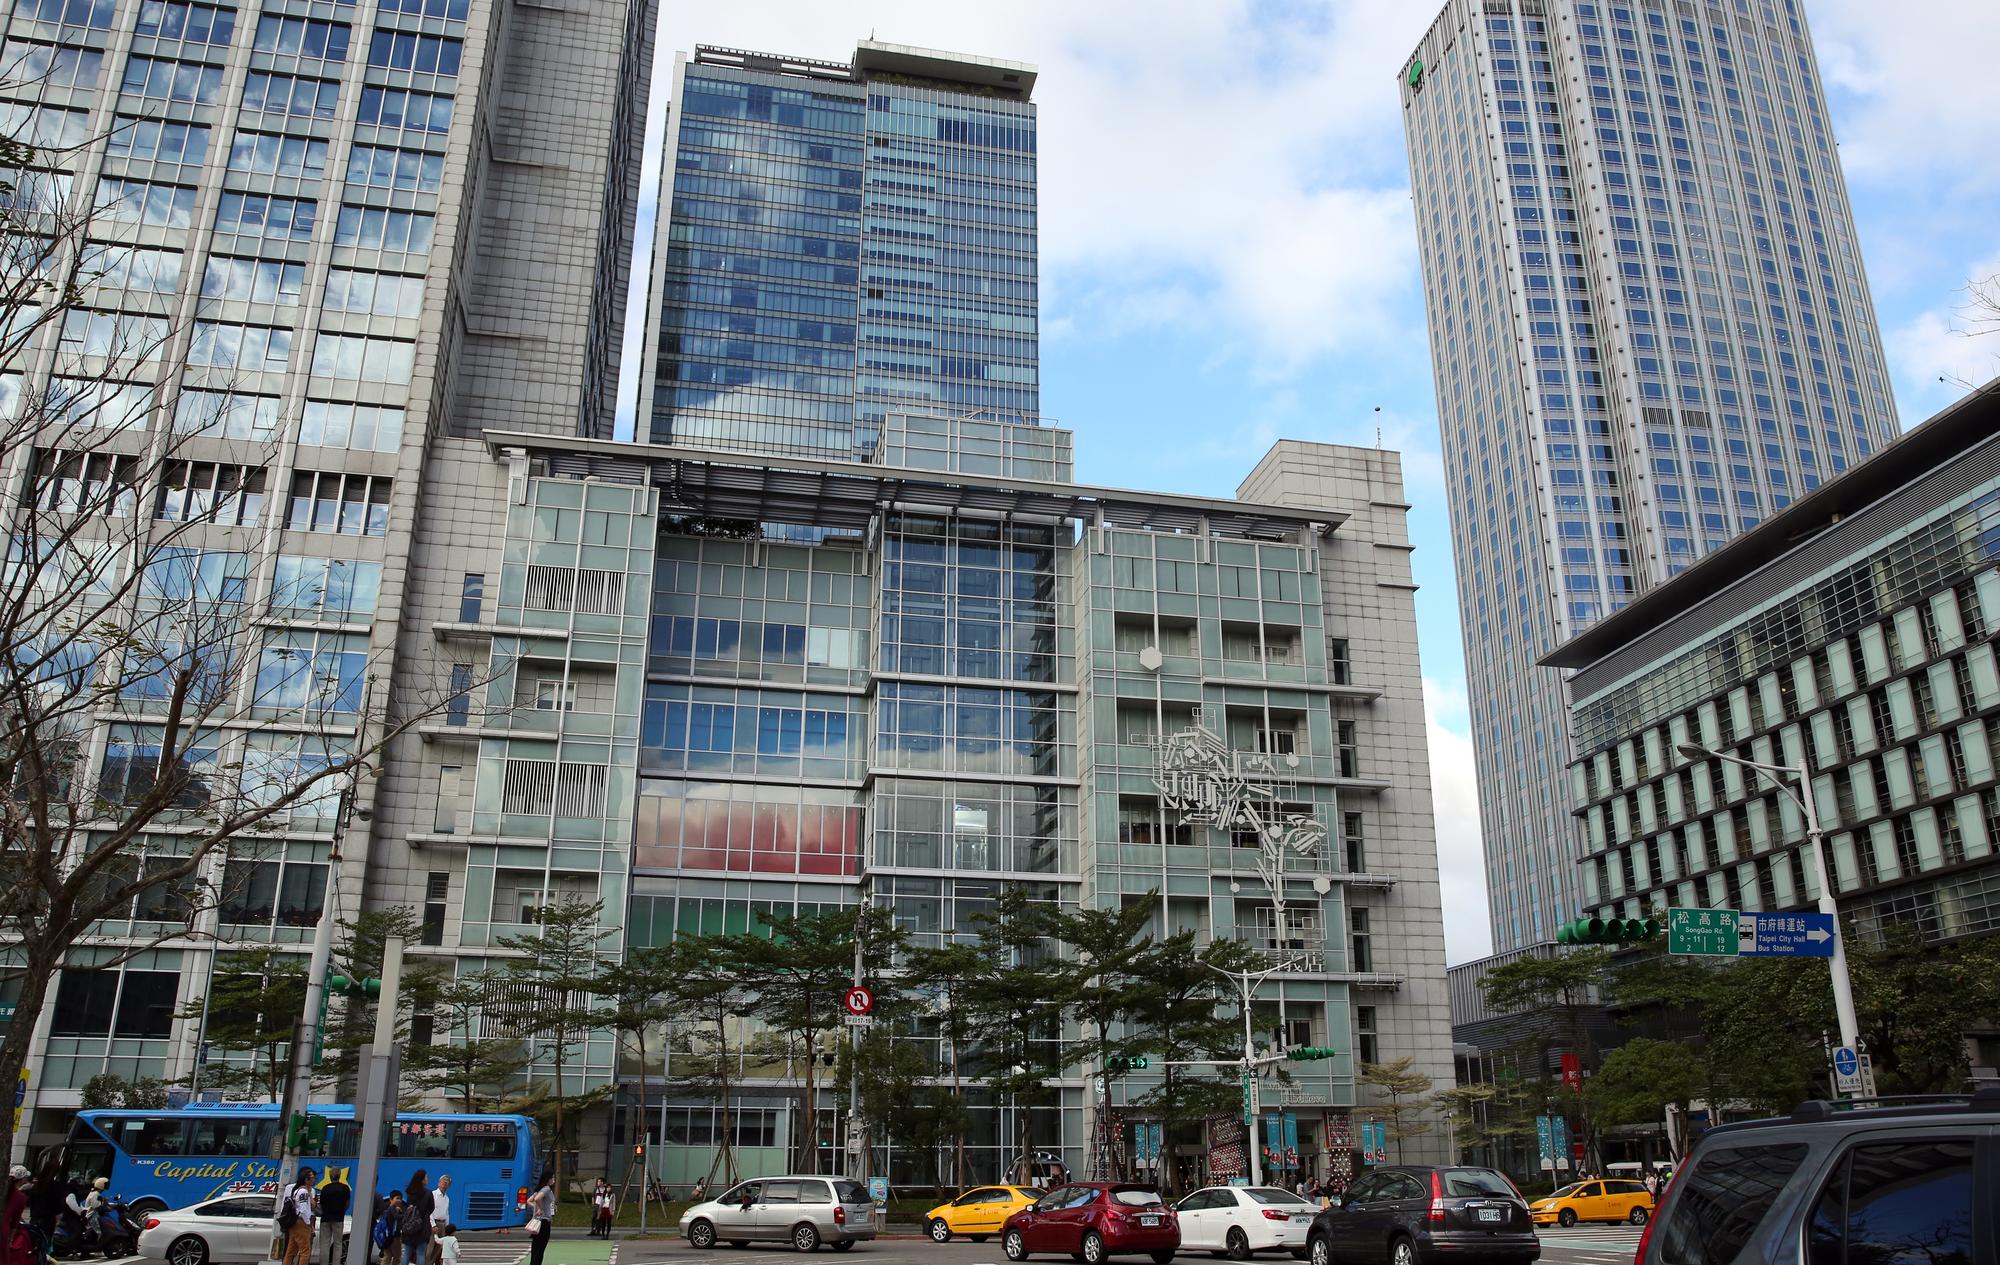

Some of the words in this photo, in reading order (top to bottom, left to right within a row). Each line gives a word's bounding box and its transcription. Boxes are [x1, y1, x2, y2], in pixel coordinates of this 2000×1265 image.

[1677, 911, 1732, 926] 松高路
[1758, 917, 1806, 933] 市府轉運站
[1685, 926, 1713, 935] SongGao
[1714, 927, 1724, 935] Rd.
[1693, 935, 1701, 943] 11
[1717, 936, 1725, 944] 19
[1758, 935, 1777, 943] Taipei
[1779, 935, 1792, 944] City
[1793, 935, 1806, 943] Hall
[1686, 944, 1692, 952] 2
[1717, 945, 1725, 953] 12
[1758, 944, 1770, 952] Bus
[1772, 944, 1795, 952] Station
[464, 1123, 505, 1133] 869-FR
[153, 1160, 235, 1182] Capital
